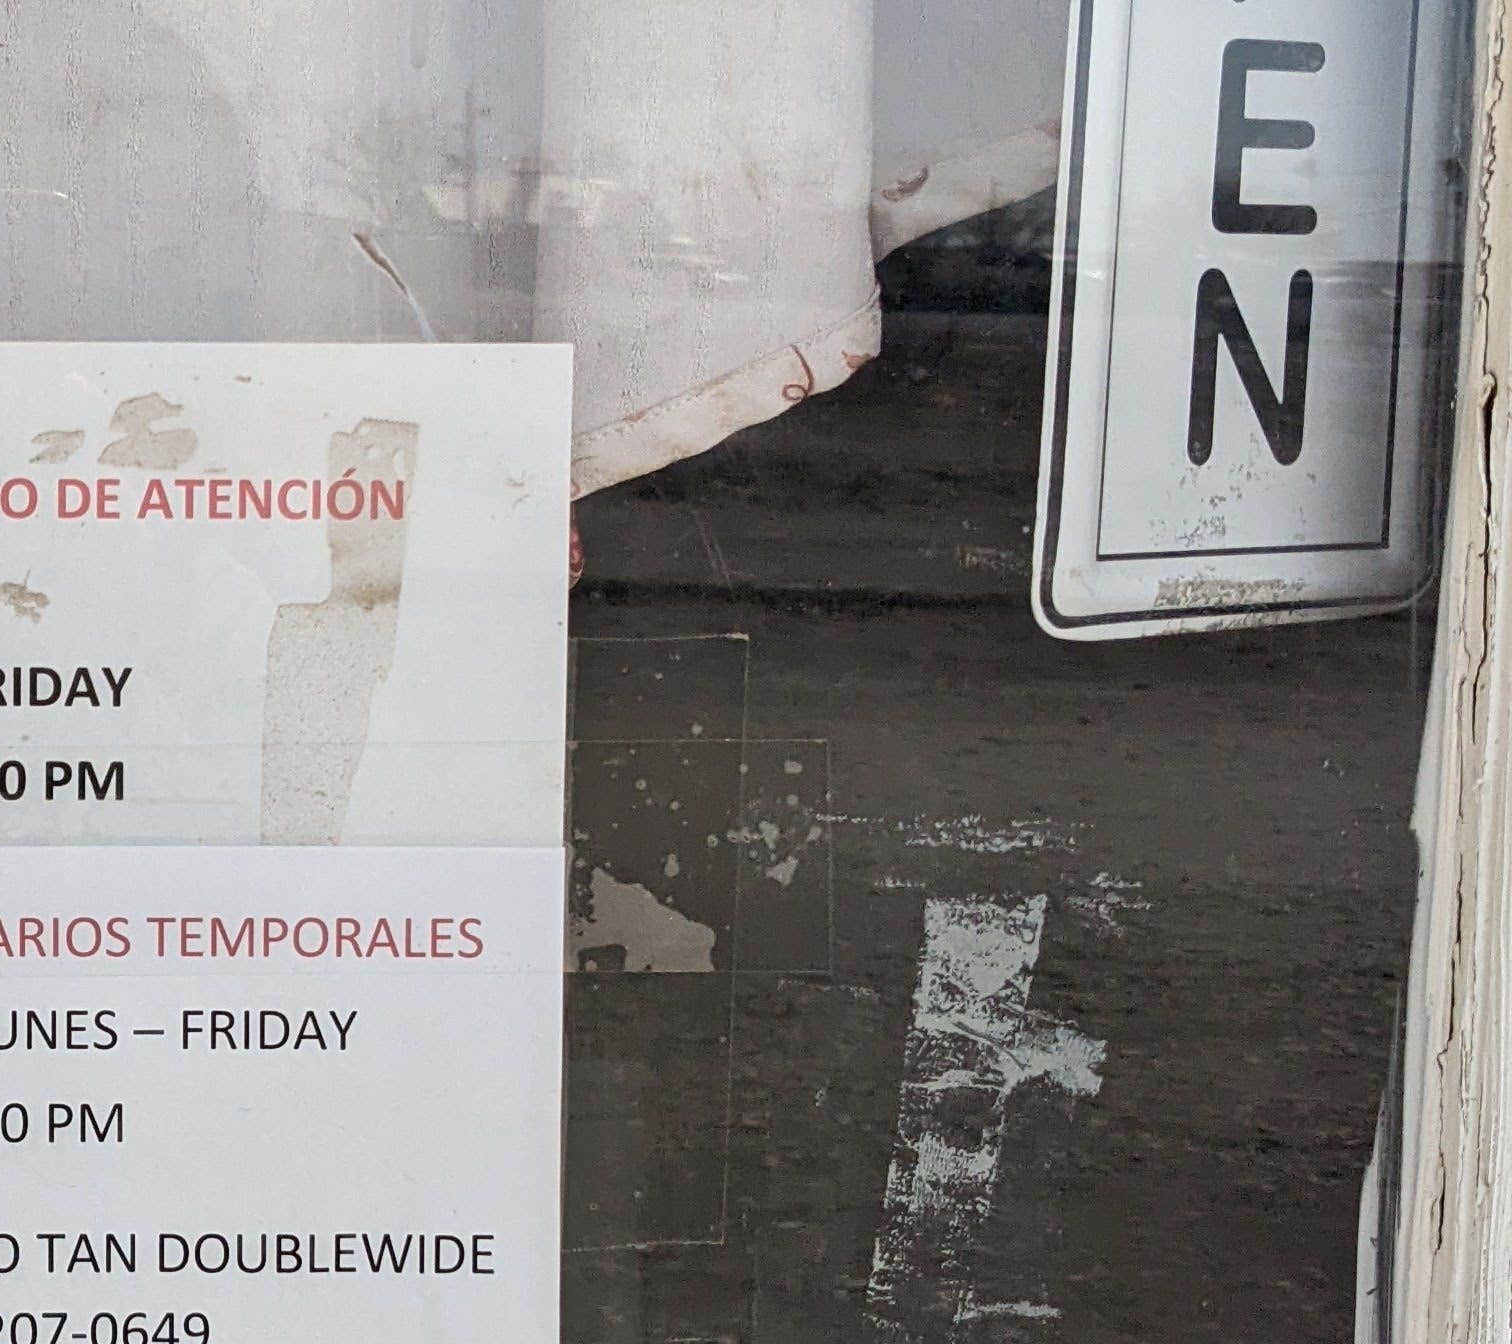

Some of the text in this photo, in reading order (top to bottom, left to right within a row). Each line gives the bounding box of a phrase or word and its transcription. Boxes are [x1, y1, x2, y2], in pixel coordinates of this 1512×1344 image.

[57, 478, 121, 520] DE
[136, 467, 405, 521] ATENCIÓN
[44, 760, 125, 802] PM
[146, 916, 484, 959] TEMPORALES
[182, 1009, 358, 1051] FRIDAY
[48, 1102, 124, 1144] PM
[35, 1233, 136, 1274] TAN
[158, 1232, 495, 1275] DOUBLEWIDE
